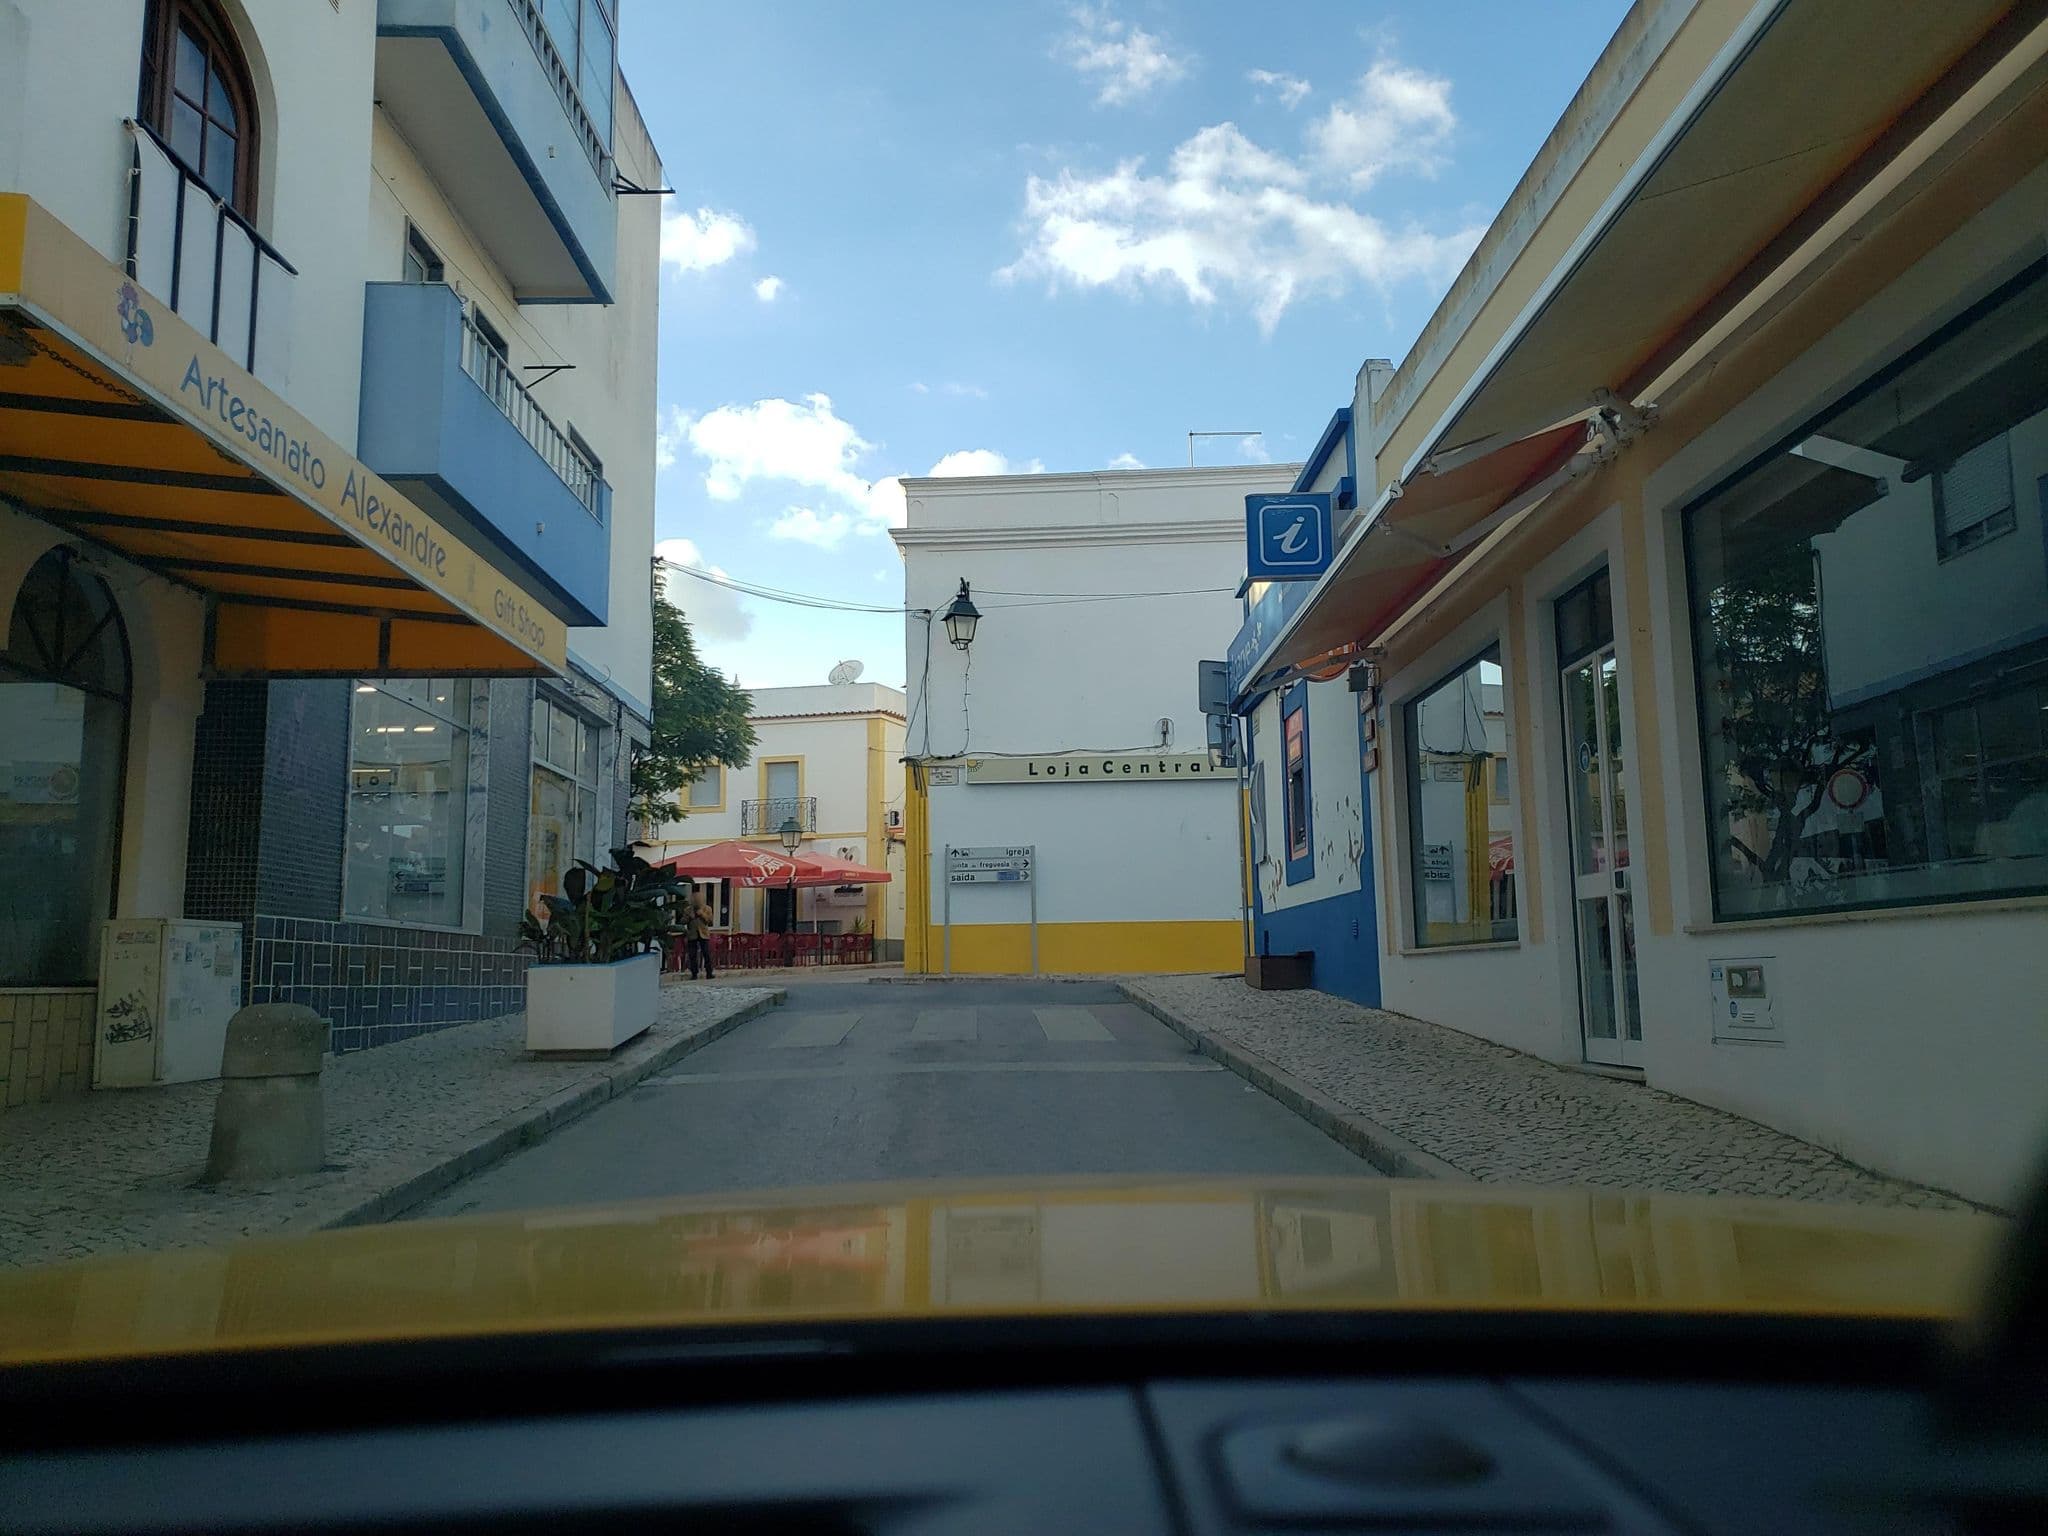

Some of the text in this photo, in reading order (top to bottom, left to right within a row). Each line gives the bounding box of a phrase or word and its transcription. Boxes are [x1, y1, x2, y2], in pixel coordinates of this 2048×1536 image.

[180, 354, 545, 648] Artesanato Alexandre Gift Shop
[1029, 762, 1089, 777] Loja
